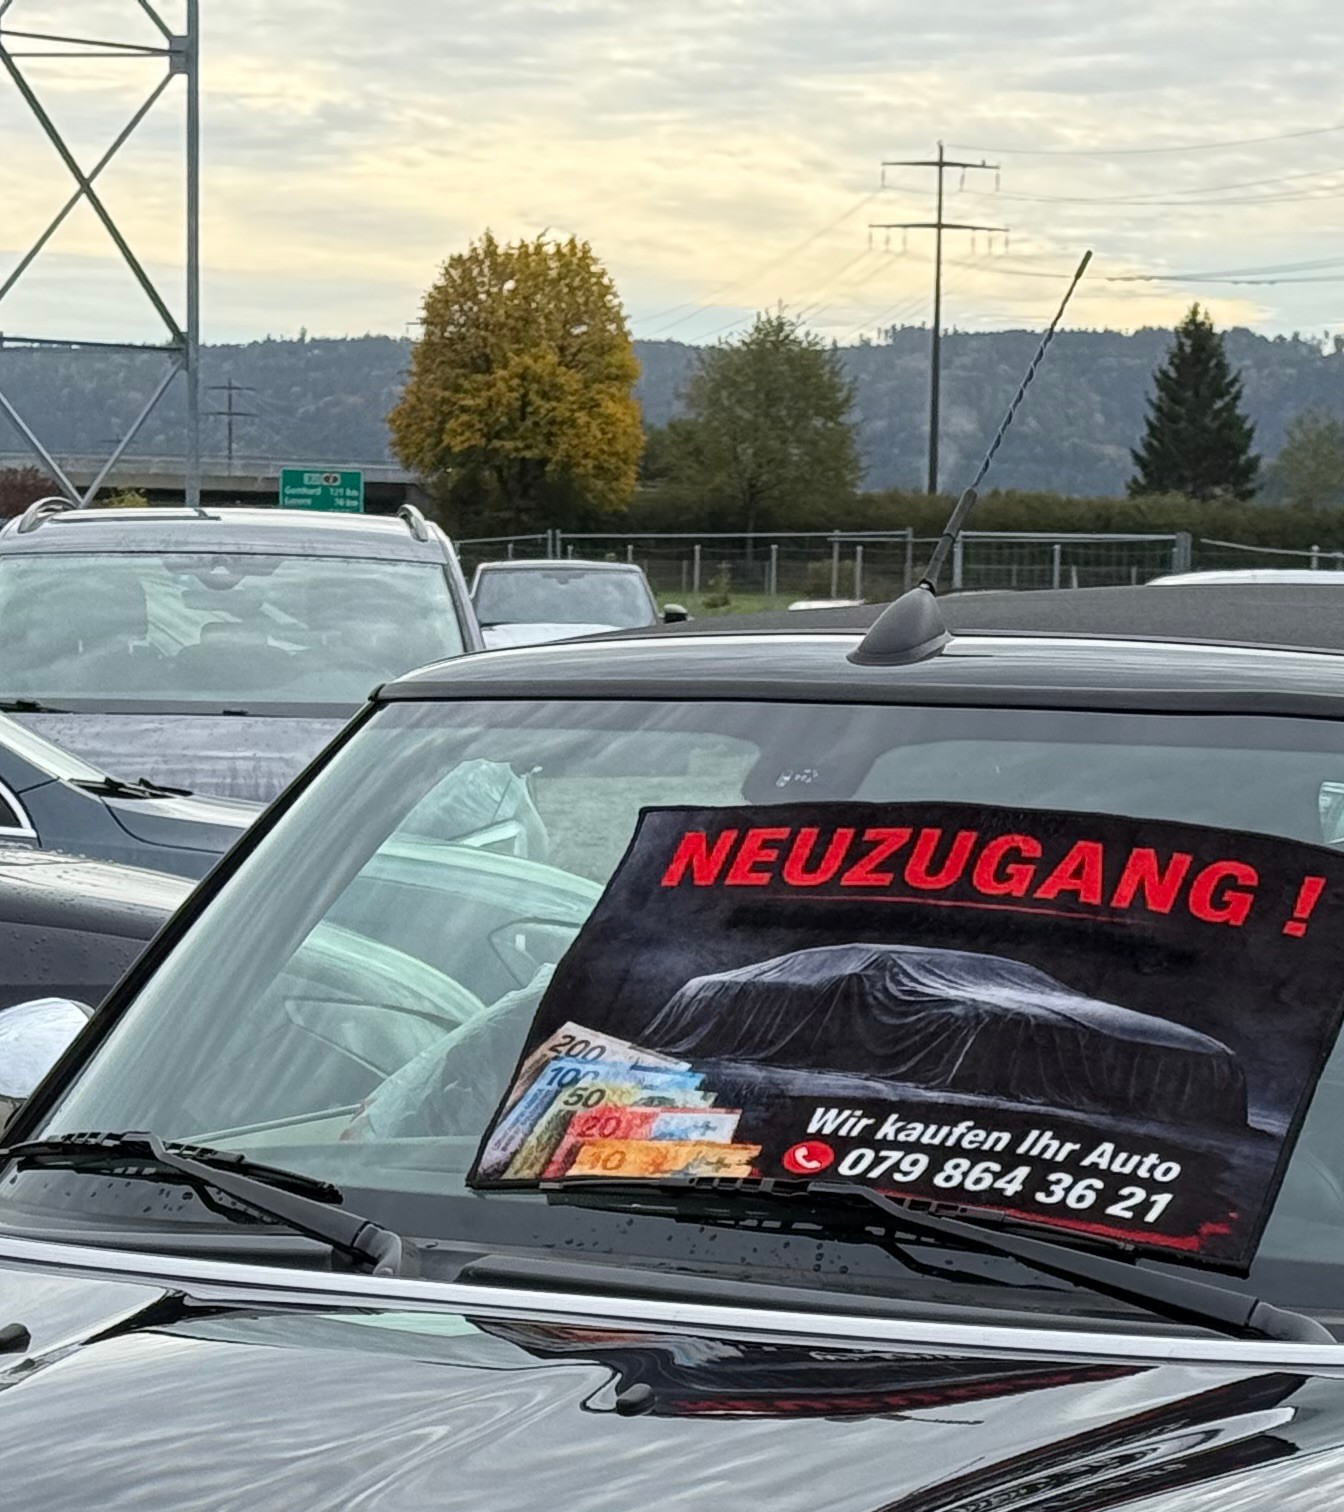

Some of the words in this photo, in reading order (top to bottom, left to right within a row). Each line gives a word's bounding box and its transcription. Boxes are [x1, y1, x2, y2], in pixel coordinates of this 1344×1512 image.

[660, 825, 1258, 928] NEUZUGANG
[1282, 875, 1327, 938] !
[549, 1034, 606, 1061] 200
[563, 1086, 606, 1108] 50
[576, 1115, 622, 1138] 20
[806, 1107, 876, 1137] Wir
[875, 1112, 1012, 1152] kaufen
[1016, 1128, 1081, 1163] Ihr
[1080, 1142, 1183, 1183] Auto
[837, 1147, 930, 1184] 079
[933, 1157, 1032, 1198] 864
[1034, 1172, 1106, 1211] 36
[1104, 1185, 1175, 1224] 21
